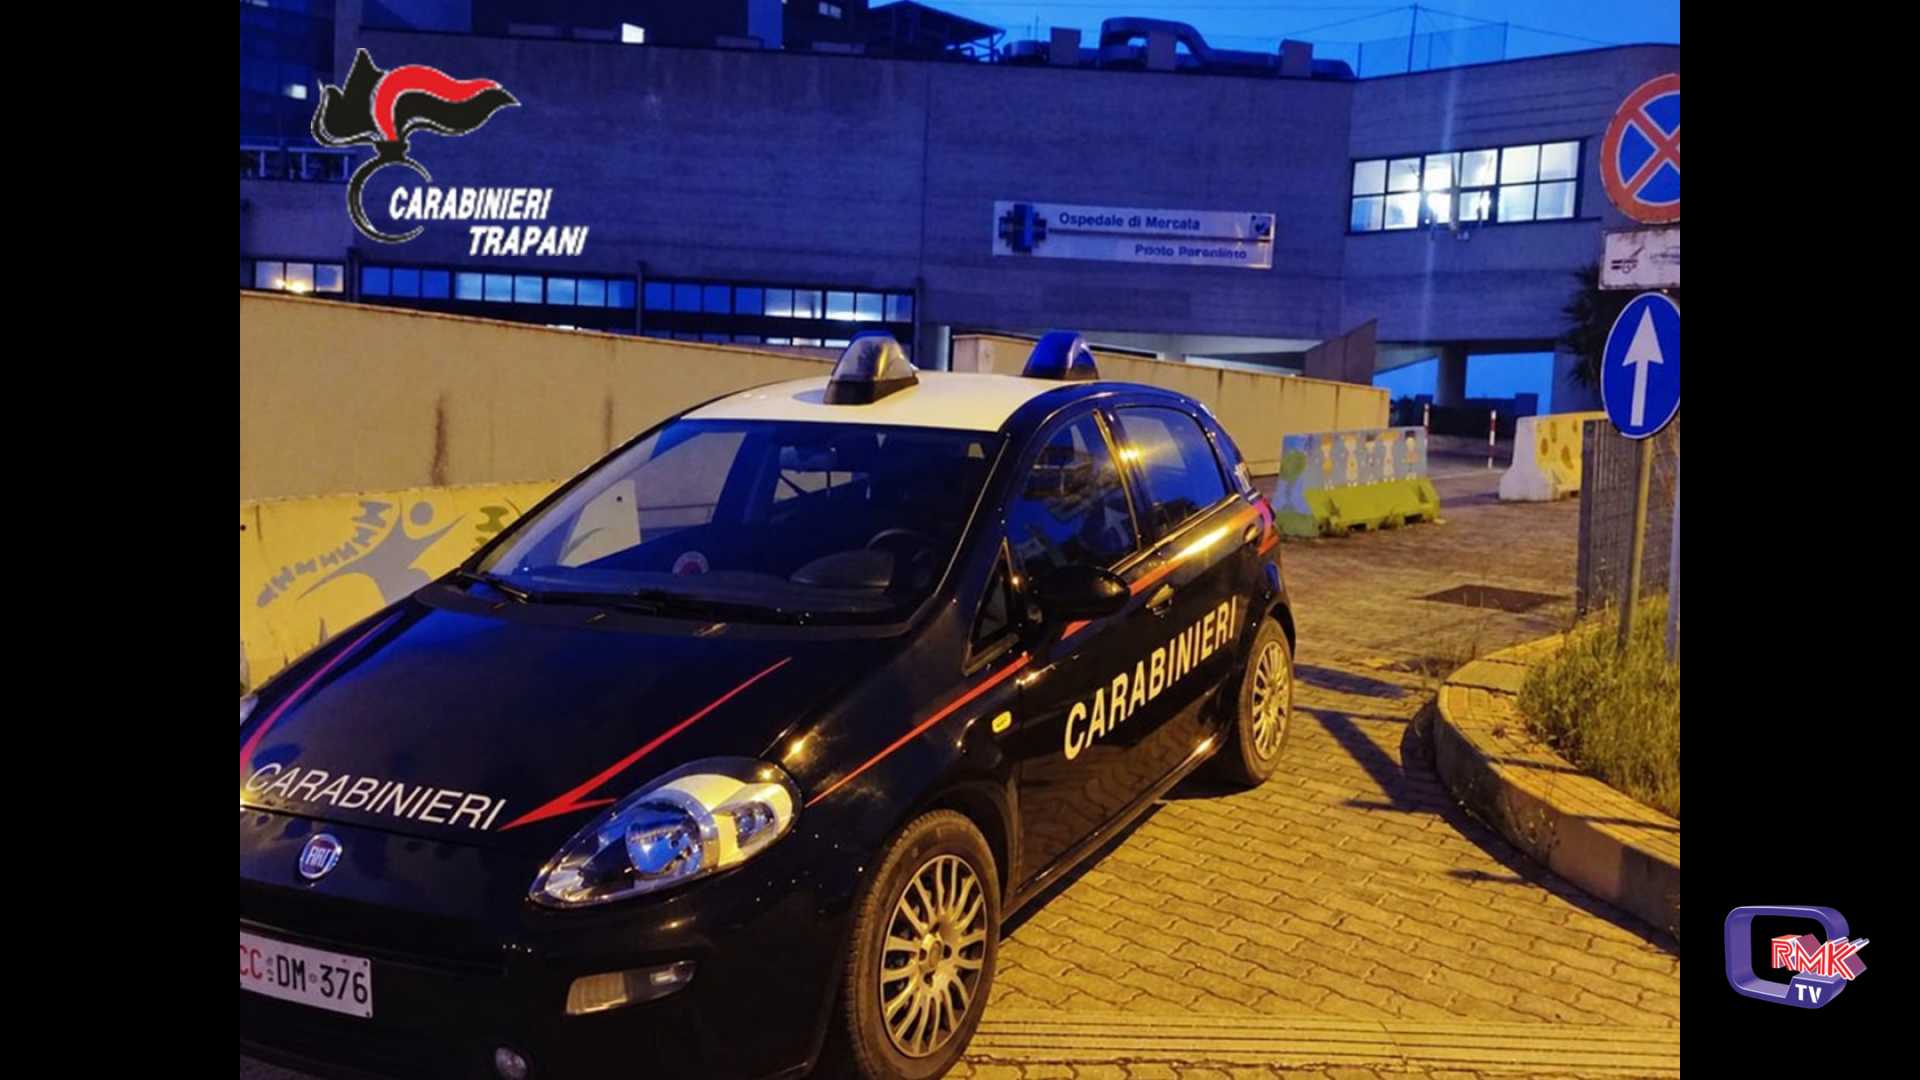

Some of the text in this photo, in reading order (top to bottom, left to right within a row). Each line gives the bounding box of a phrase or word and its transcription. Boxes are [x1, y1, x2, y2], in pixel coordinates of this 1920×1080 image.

[1059, 212, 1124, 227] Ospedale
[1128, 215, 1141, 228] di
[1063, 594, 1238, 761] CARABINIERI
[244, 762, 507, 831] CARABINIERI
[277, 954, 307, 992] DM
[319, 964, 369, 1005] 376
